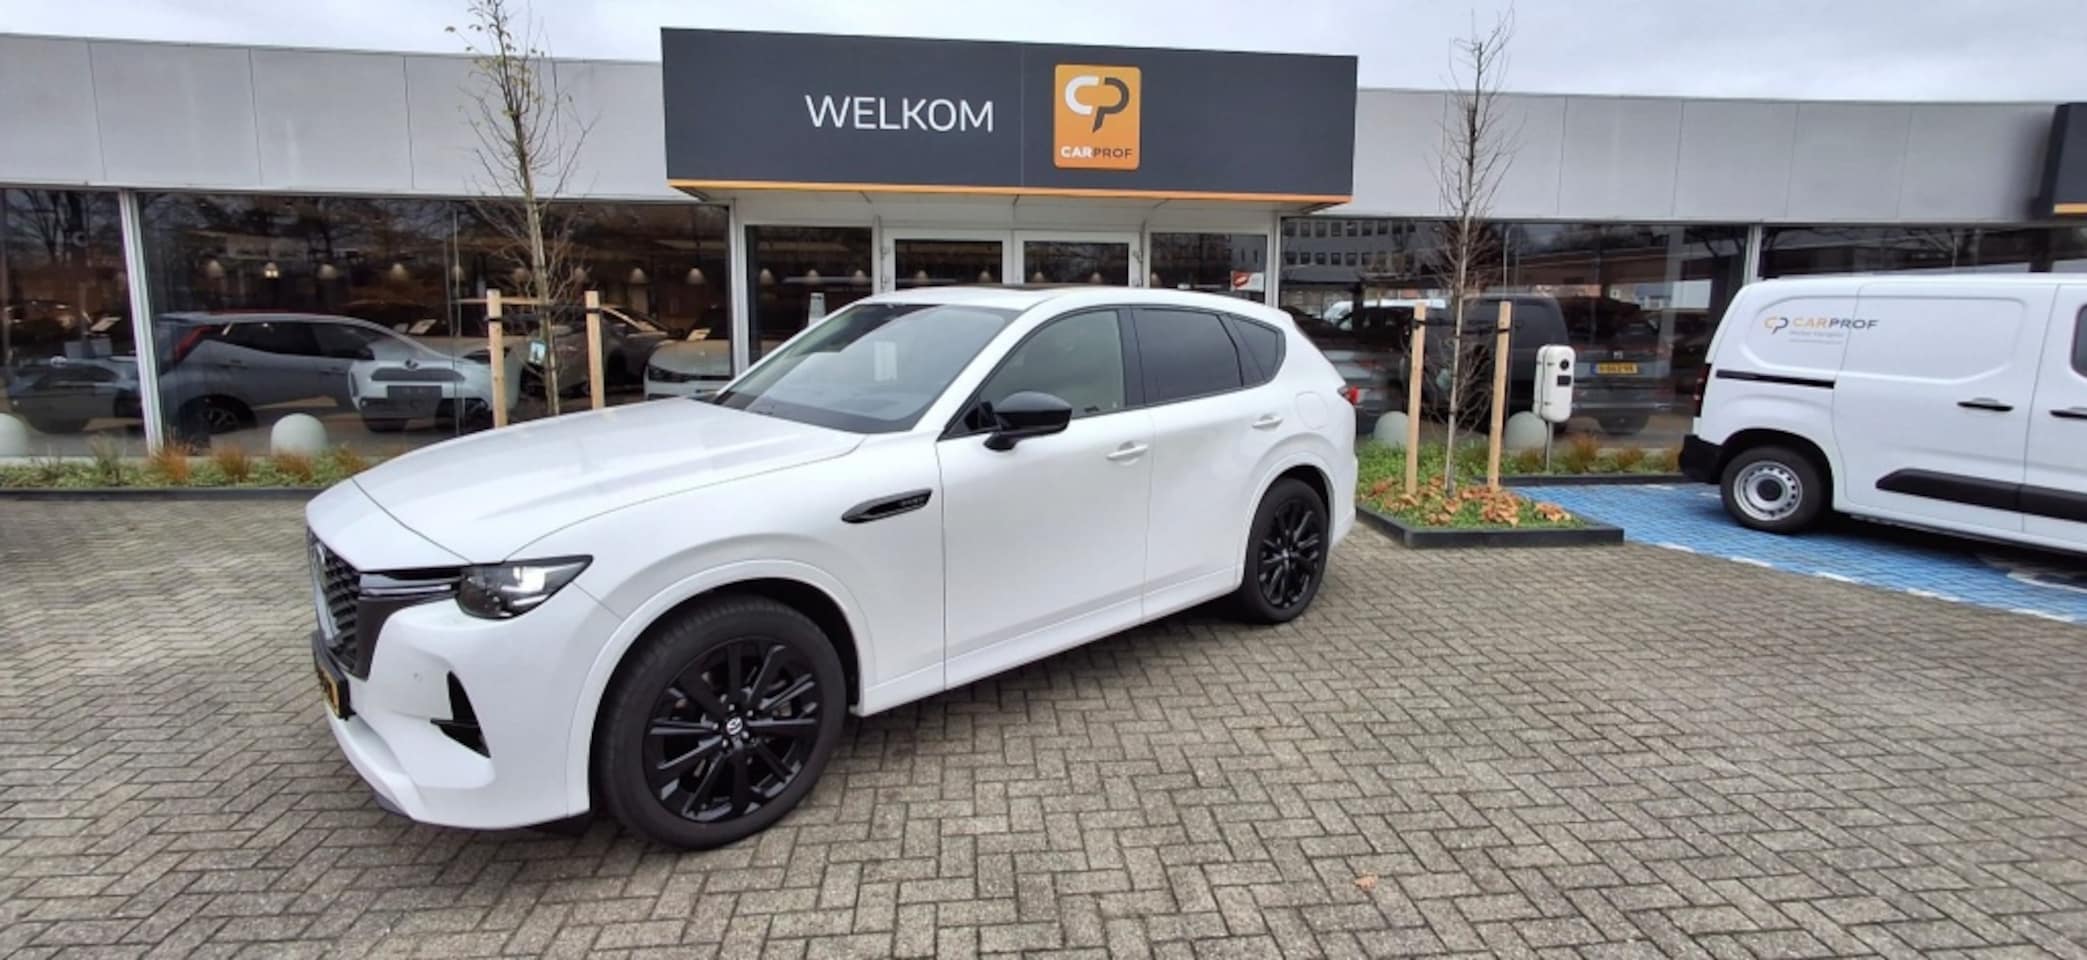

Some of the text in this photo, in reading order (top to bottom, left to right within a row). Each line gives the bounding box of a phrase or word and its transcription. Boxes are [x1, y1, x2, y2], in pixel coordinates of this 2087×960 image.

[804, 94, 994, 133] WELKOM
[1060, 145, 1133, 158] CARPROF
[1792, 317, 1878, 329] CARPROF
